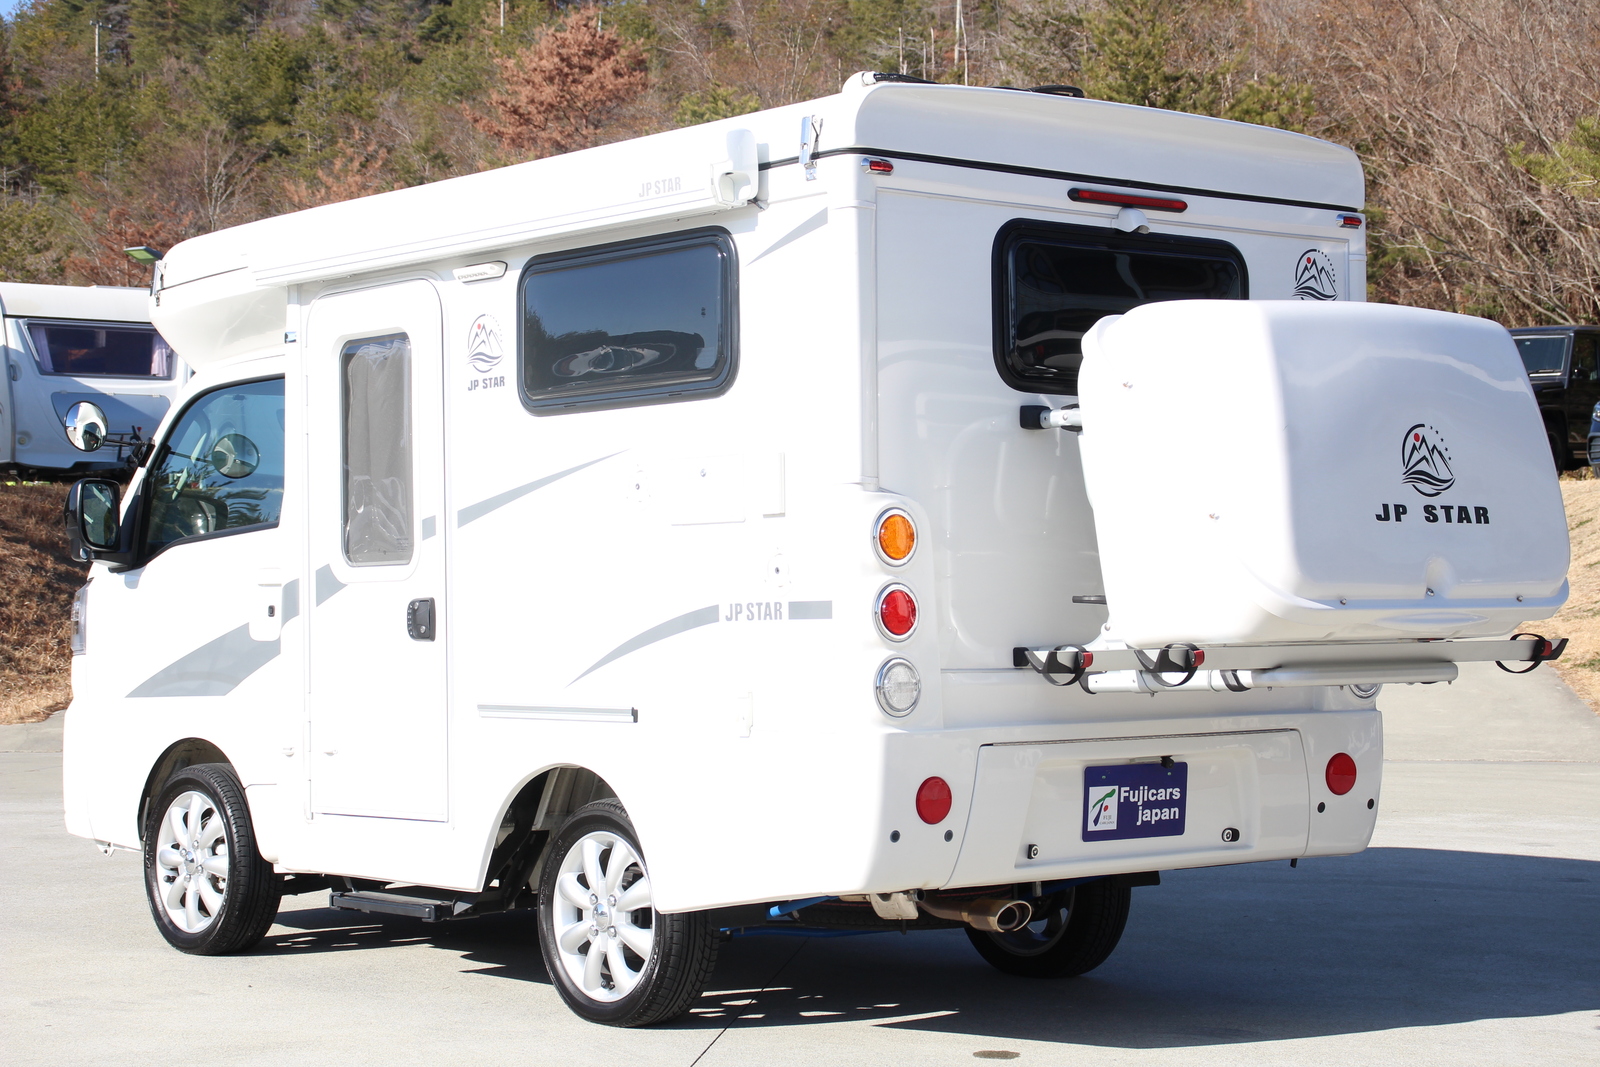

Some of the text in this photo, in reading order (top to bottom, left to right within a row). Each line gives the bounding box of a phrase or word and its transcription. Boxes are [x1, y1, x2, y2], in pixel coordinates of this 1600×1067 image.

[638, 176, 682, 198] JP STAR
[467, 376, 505, 391] JP STAR
[1375, 503, 1490, 525] JP STAR
[725, 601, 783, 622] JP STAR
[1120, 785, 1181, 806] Fujicars
[1136, 805, 1180, 826] japan
